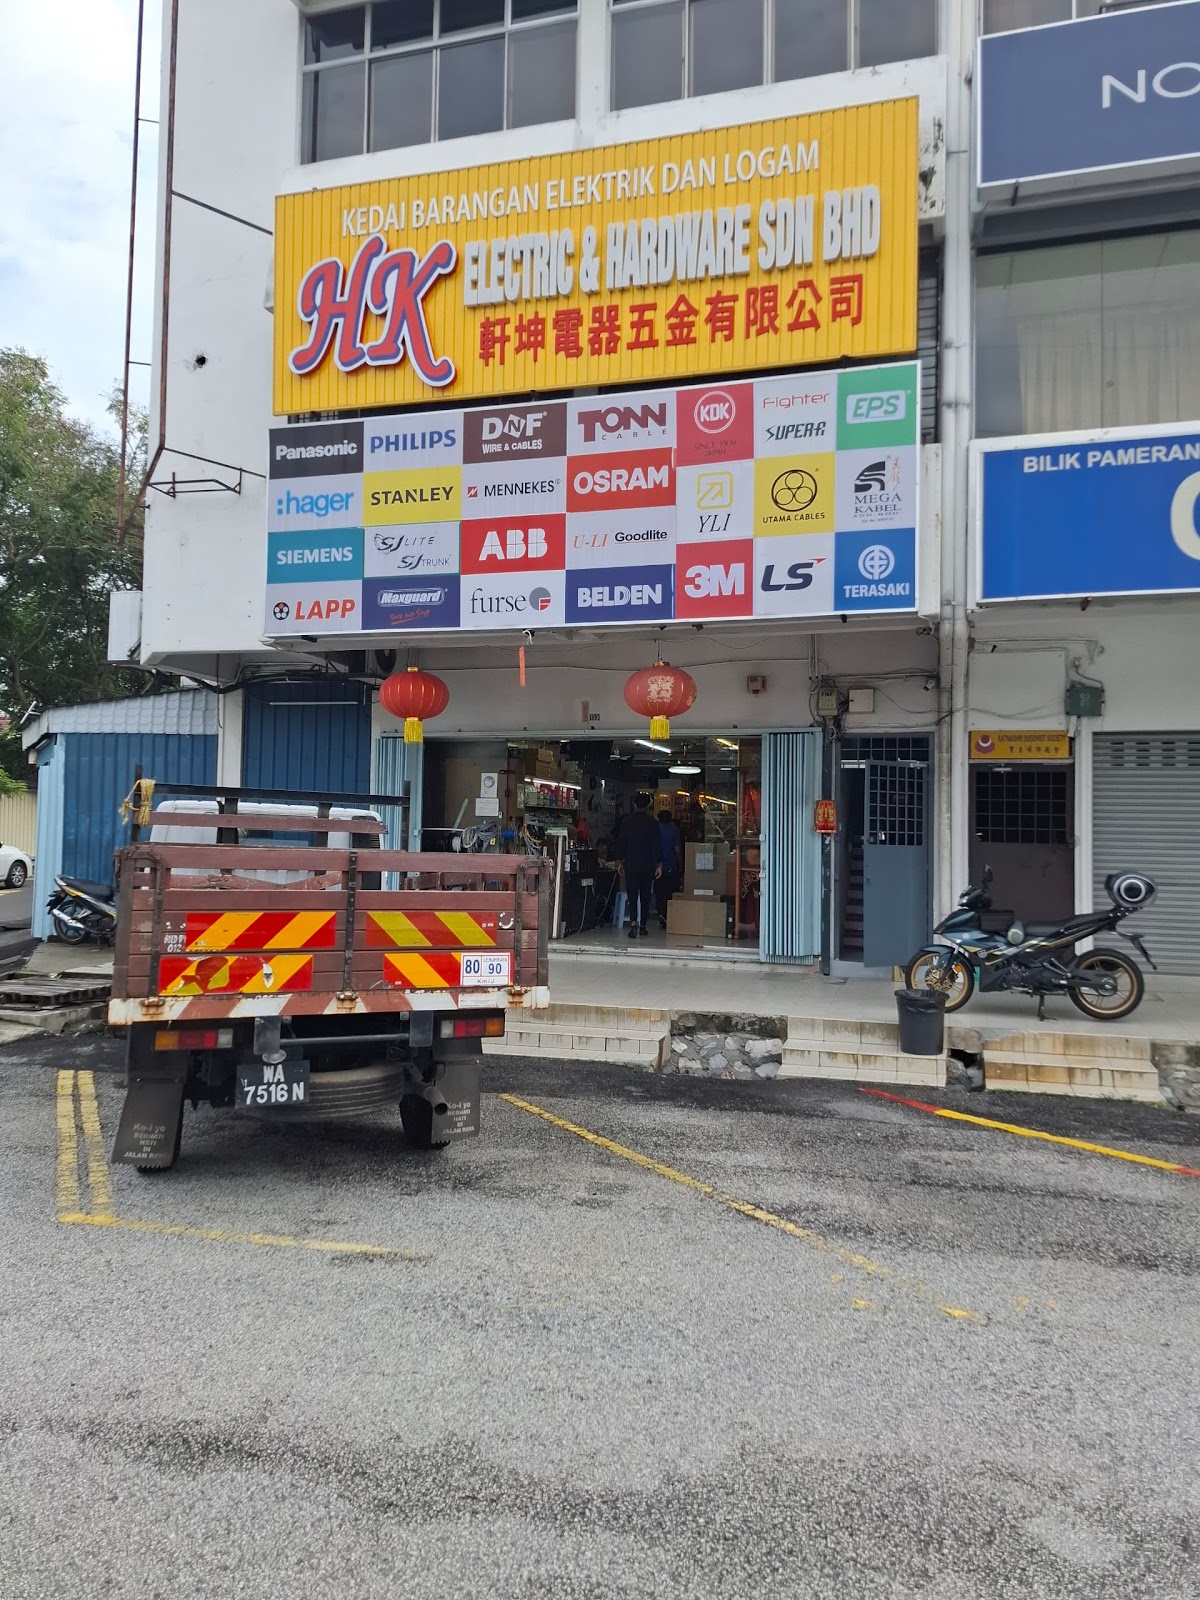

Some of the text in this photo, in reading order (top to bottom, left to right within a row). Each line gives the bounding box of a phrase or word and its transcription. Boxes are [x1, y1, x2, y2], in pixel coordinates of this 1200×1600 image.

[1102, 62, 1200, 108] NO
[342, 139, 820, 237] KEDAI BARANGAN ELEKTRIK DAN LOGAM
[463, 185, 881, 308] ELECTRIC & HARDWARE SDN BHD
[289, 232, 457, 387] HK
[479, 273, 864, 367] 軒坤電器五金有限公司
[763, 393, 830, 409] Fighter
[852, 395, 900, 419] EPS
[577, 403, 667, 443] TONN
[700, 402, 730, 423] KDK
[482, 412, 543, 440] DNF
[602, 429, 667, 441] CABLE
[275, 440, 358, 461] Panasonic
[370, 429, 457, 454] PHILIPS
[482, 439, 543, 454] WIRE & CABLES
[1023, 443, 1200, 473] BILIK PAMERAN
[484, 480, 555, 497] MENNEKES
[573, 465, 669, 495] OSRAM
[371, 486, 454, 506] STANLEY
[854, 493, 902, 504] MEGA
[763, 512, 826, 523] UTAMA CABLES
[854, 504, 902, 514] KABEL
[698, 514, 732, 533] YLI
[479, 528, 548, 561] ABB
[573, 533, 608, 549] U-LI
[614, 530, 668, 542] Goodlite
[276, 546, 353, 566] SIEMENS
[685, 563, 745, 598] 3M
[760, 562, 814, 592] LS
[380, 591, 441, 605] Maxguard
[470, 588, 527, 614] furse
[577, 584, 662, 608] BELDEN
[843, 583, 910, 598] TERASAKI
[294, 599, 356, 621] LAPP
[465, 959, 480, 974] 80
[488, 963, 502, 975] 90
[263, 1064, 285, 1083] WA
[244, 1082, 304, 1105] 7516 N
[123, 1151, 148, 1159] JALAN
